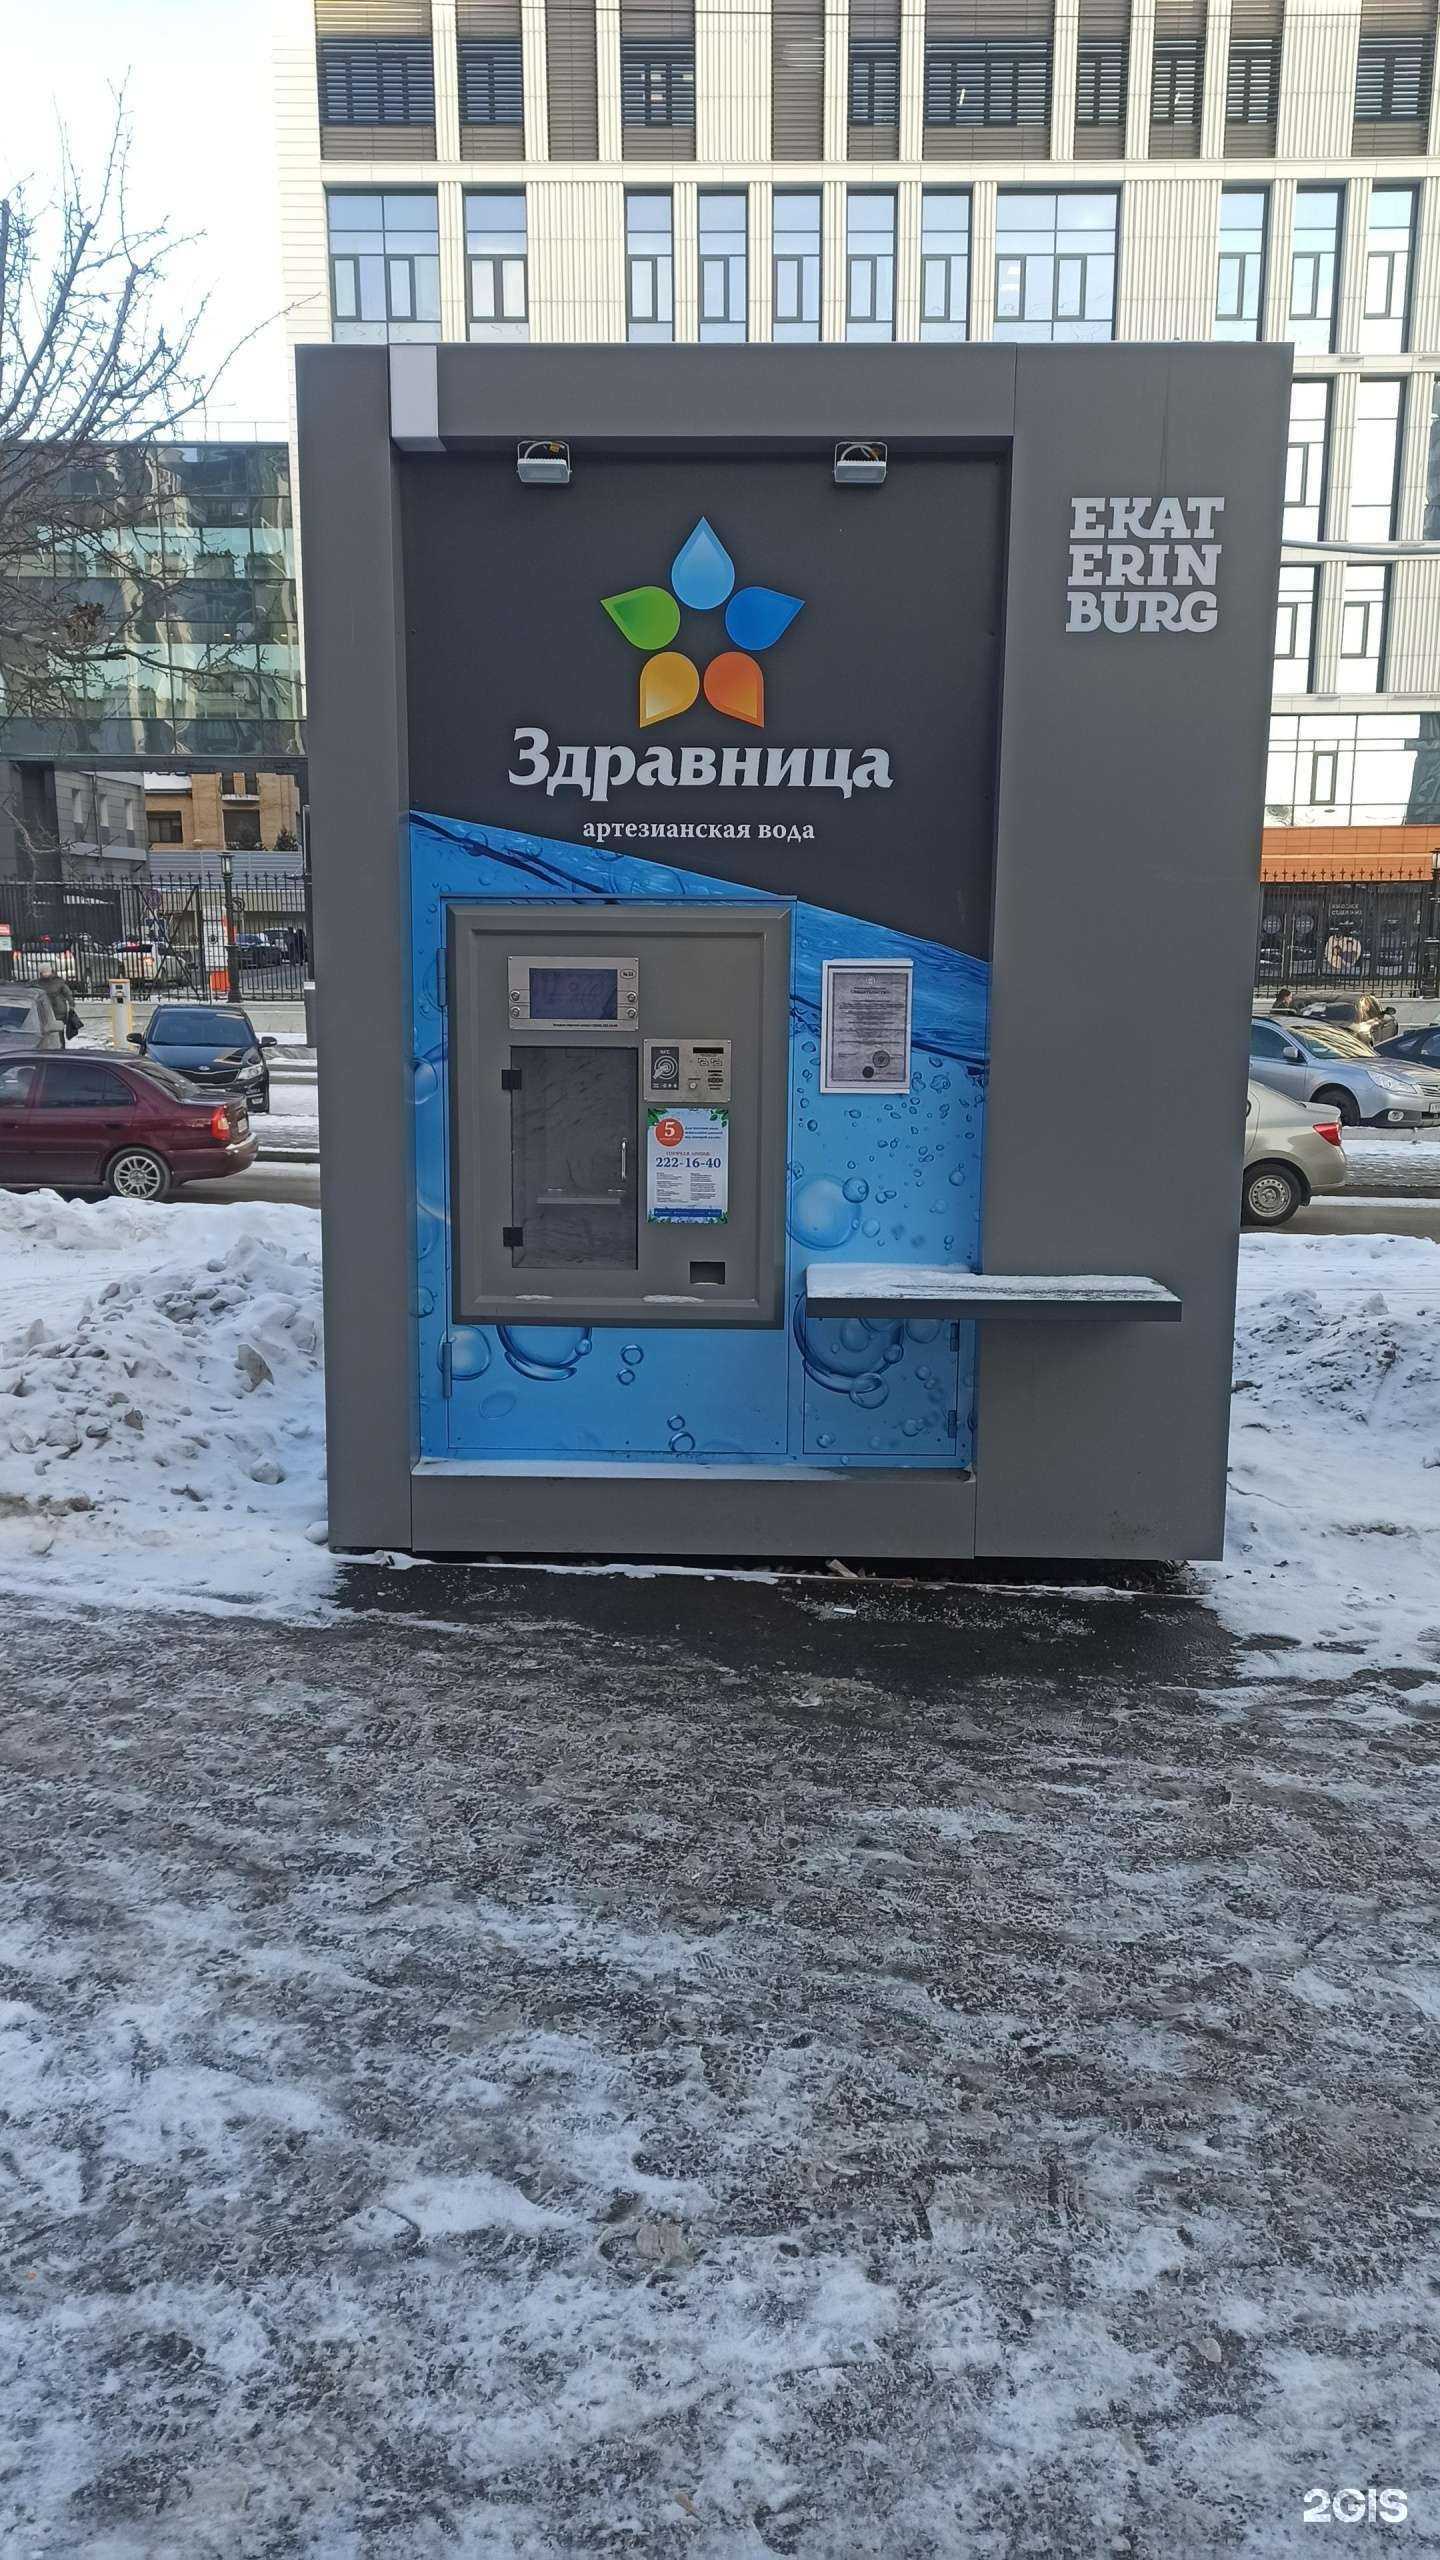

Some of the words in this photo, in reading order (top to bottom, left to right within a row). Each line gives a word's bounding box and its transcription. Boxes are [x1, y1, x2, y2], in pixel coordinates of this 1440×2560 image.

[1069, 496, 1225, 539] EKAT
[1067, 544, 1222, 586] ERIN
[1065, 590, 1219, 633] BURG
[508, 726, 896, 802] Здравница
[582, 820, 751, 842] артезианская
[758, 823, 815, 843] вода
[664, 1121, 676, 1137] 5
[655, 1157, 722, 1168] 222-16-40
